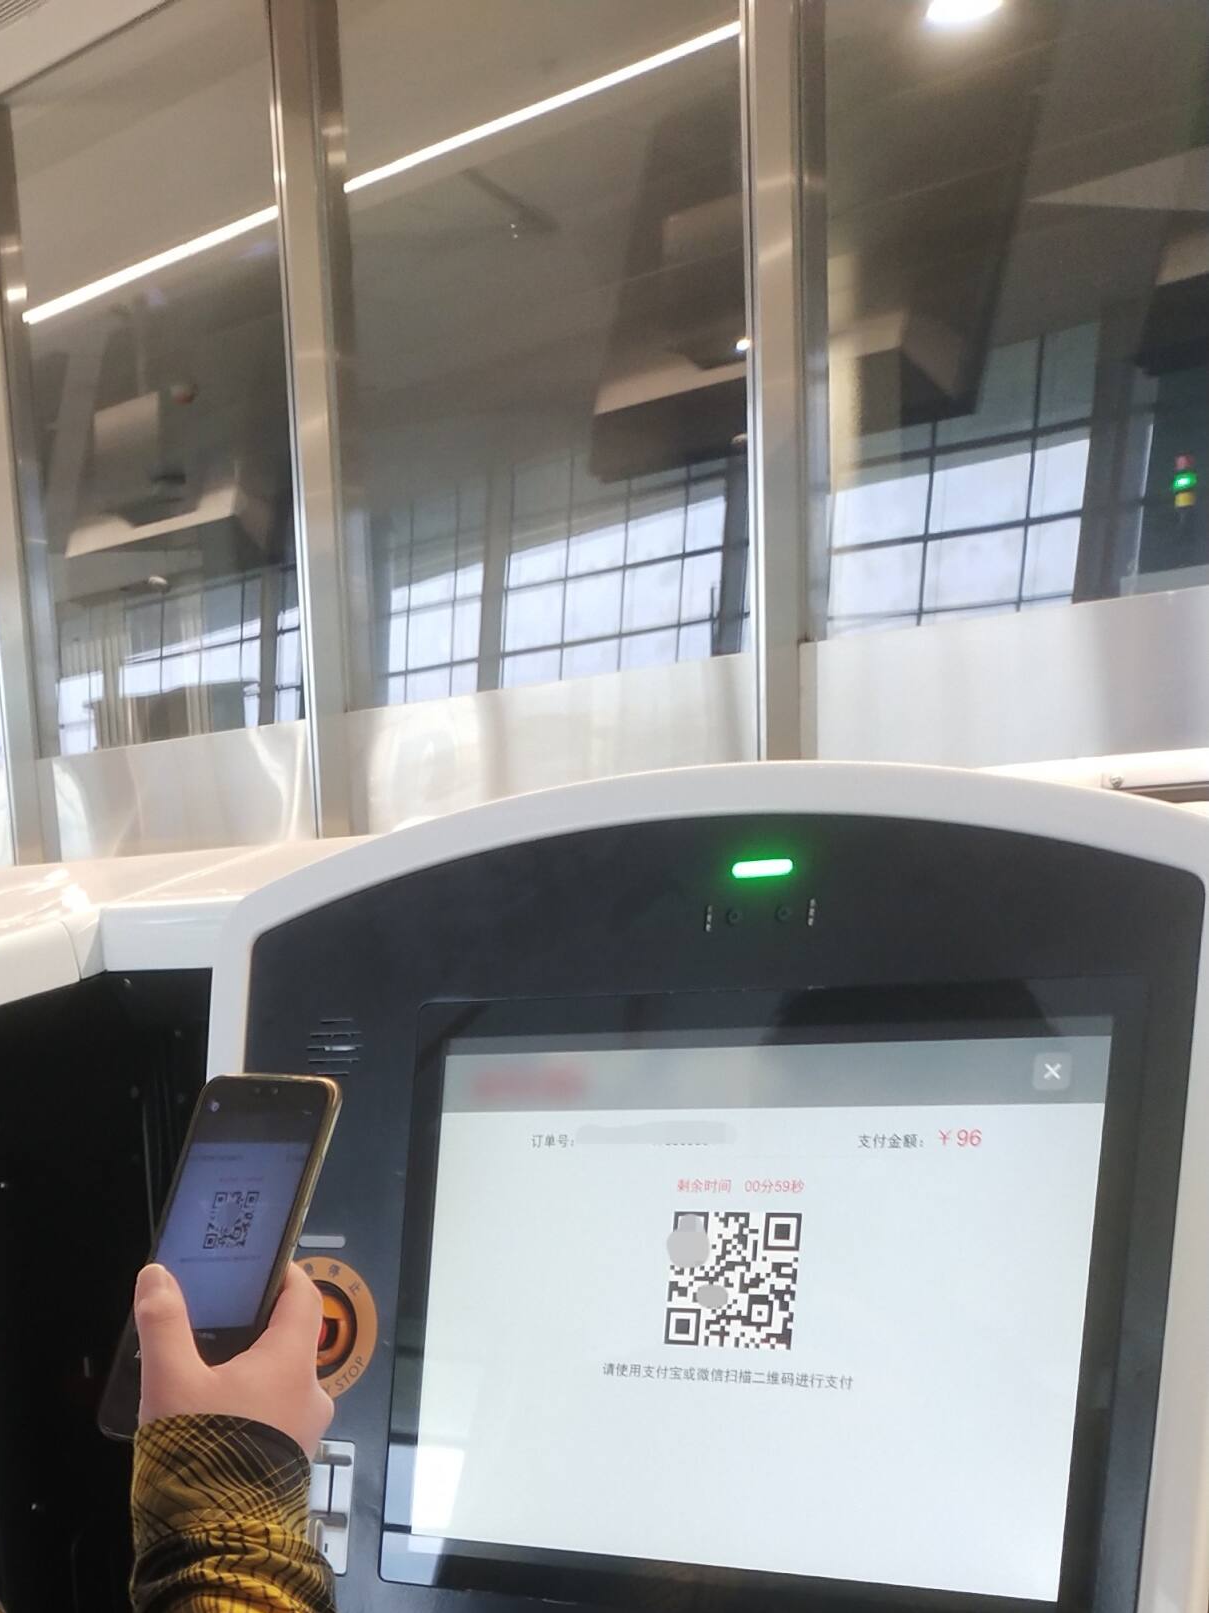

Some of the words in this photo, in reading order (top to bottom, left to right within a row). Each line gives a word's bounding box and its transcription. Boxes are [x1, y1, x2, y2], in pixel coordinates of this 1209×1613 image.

[531, 1133, 575, 1149] 订单号：
[857, 1132, 925, 1149] 支付金额：
[676, 1179, 733, 1194] 剩余时间
[743, 1178, 806, 1194] 00分59秒
[334, 1355, 365, 1392] STOP
[601, 1361, 854, 1391] 请使用支付宝或微信扫描二维码进行支付
